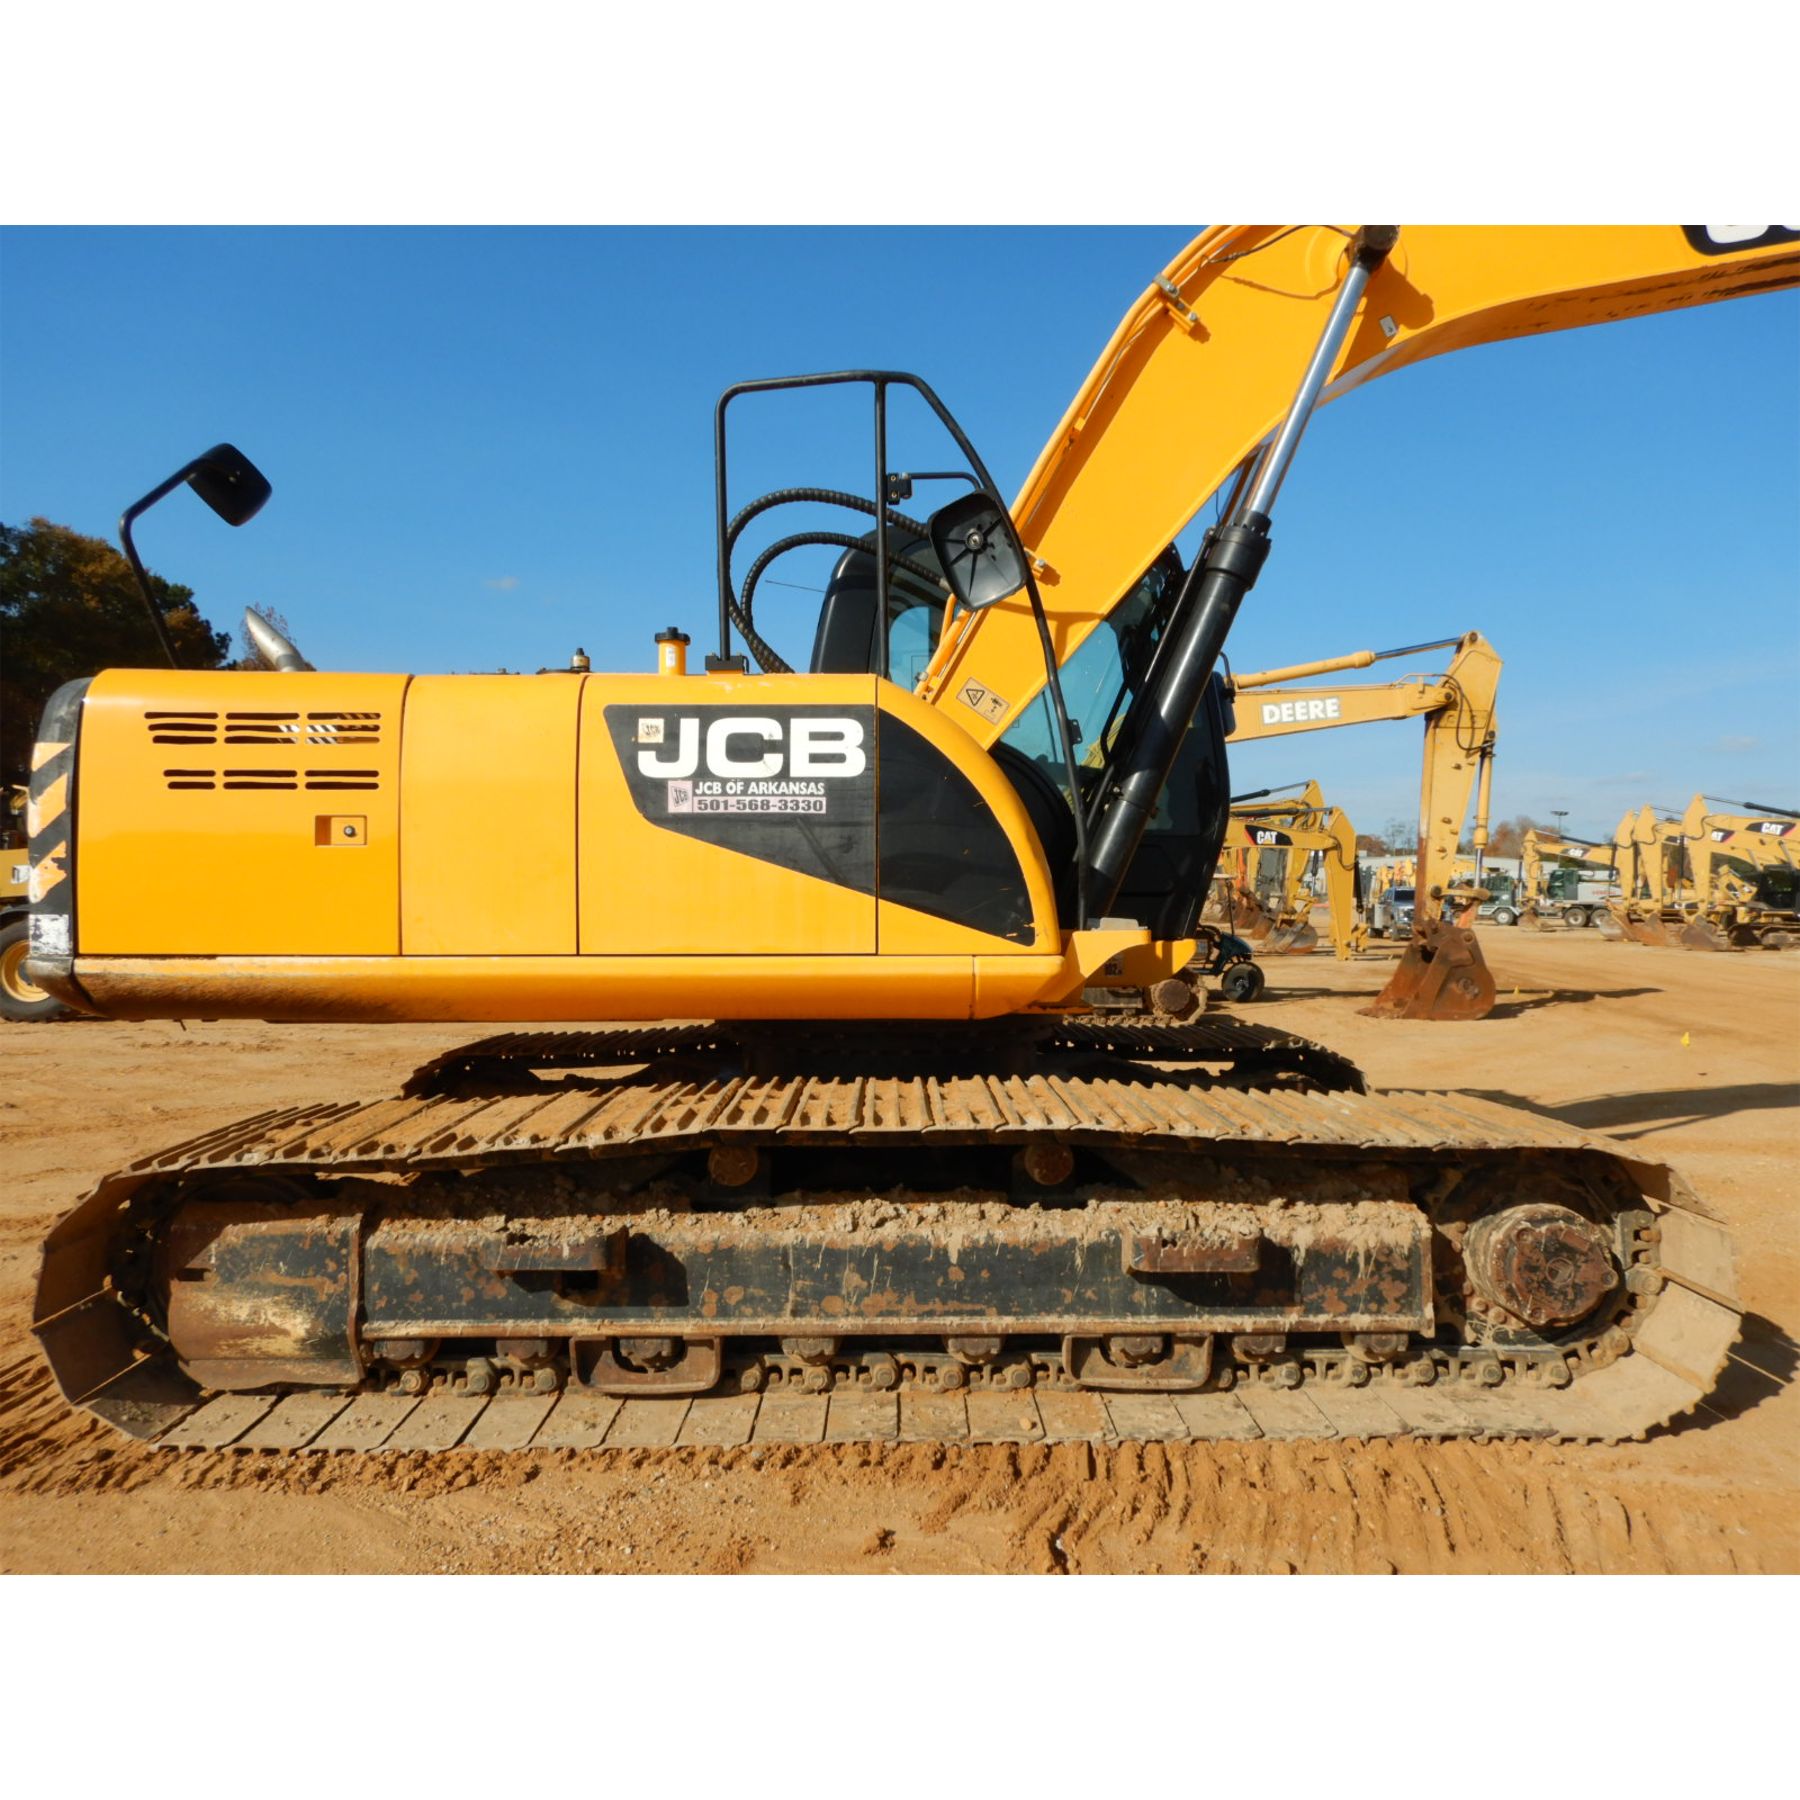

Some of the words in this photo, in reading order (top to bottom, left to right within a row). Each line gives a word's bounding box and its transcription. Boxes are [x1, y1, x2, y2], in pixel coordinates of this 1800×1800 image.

[1262, 697, 1340, 724] DEERE
[638, 717, 866, 778] JCB
[695, 781, 722, 795] JCB
[726, 781, 744, 795] OF
[748, 781, 825, 796] ARKANSAS
[697, 798, 824, 812] 501-568-3330
[1761, 822, 1785, 836] CAT
[1256, 830, 1278, 845] CAT
